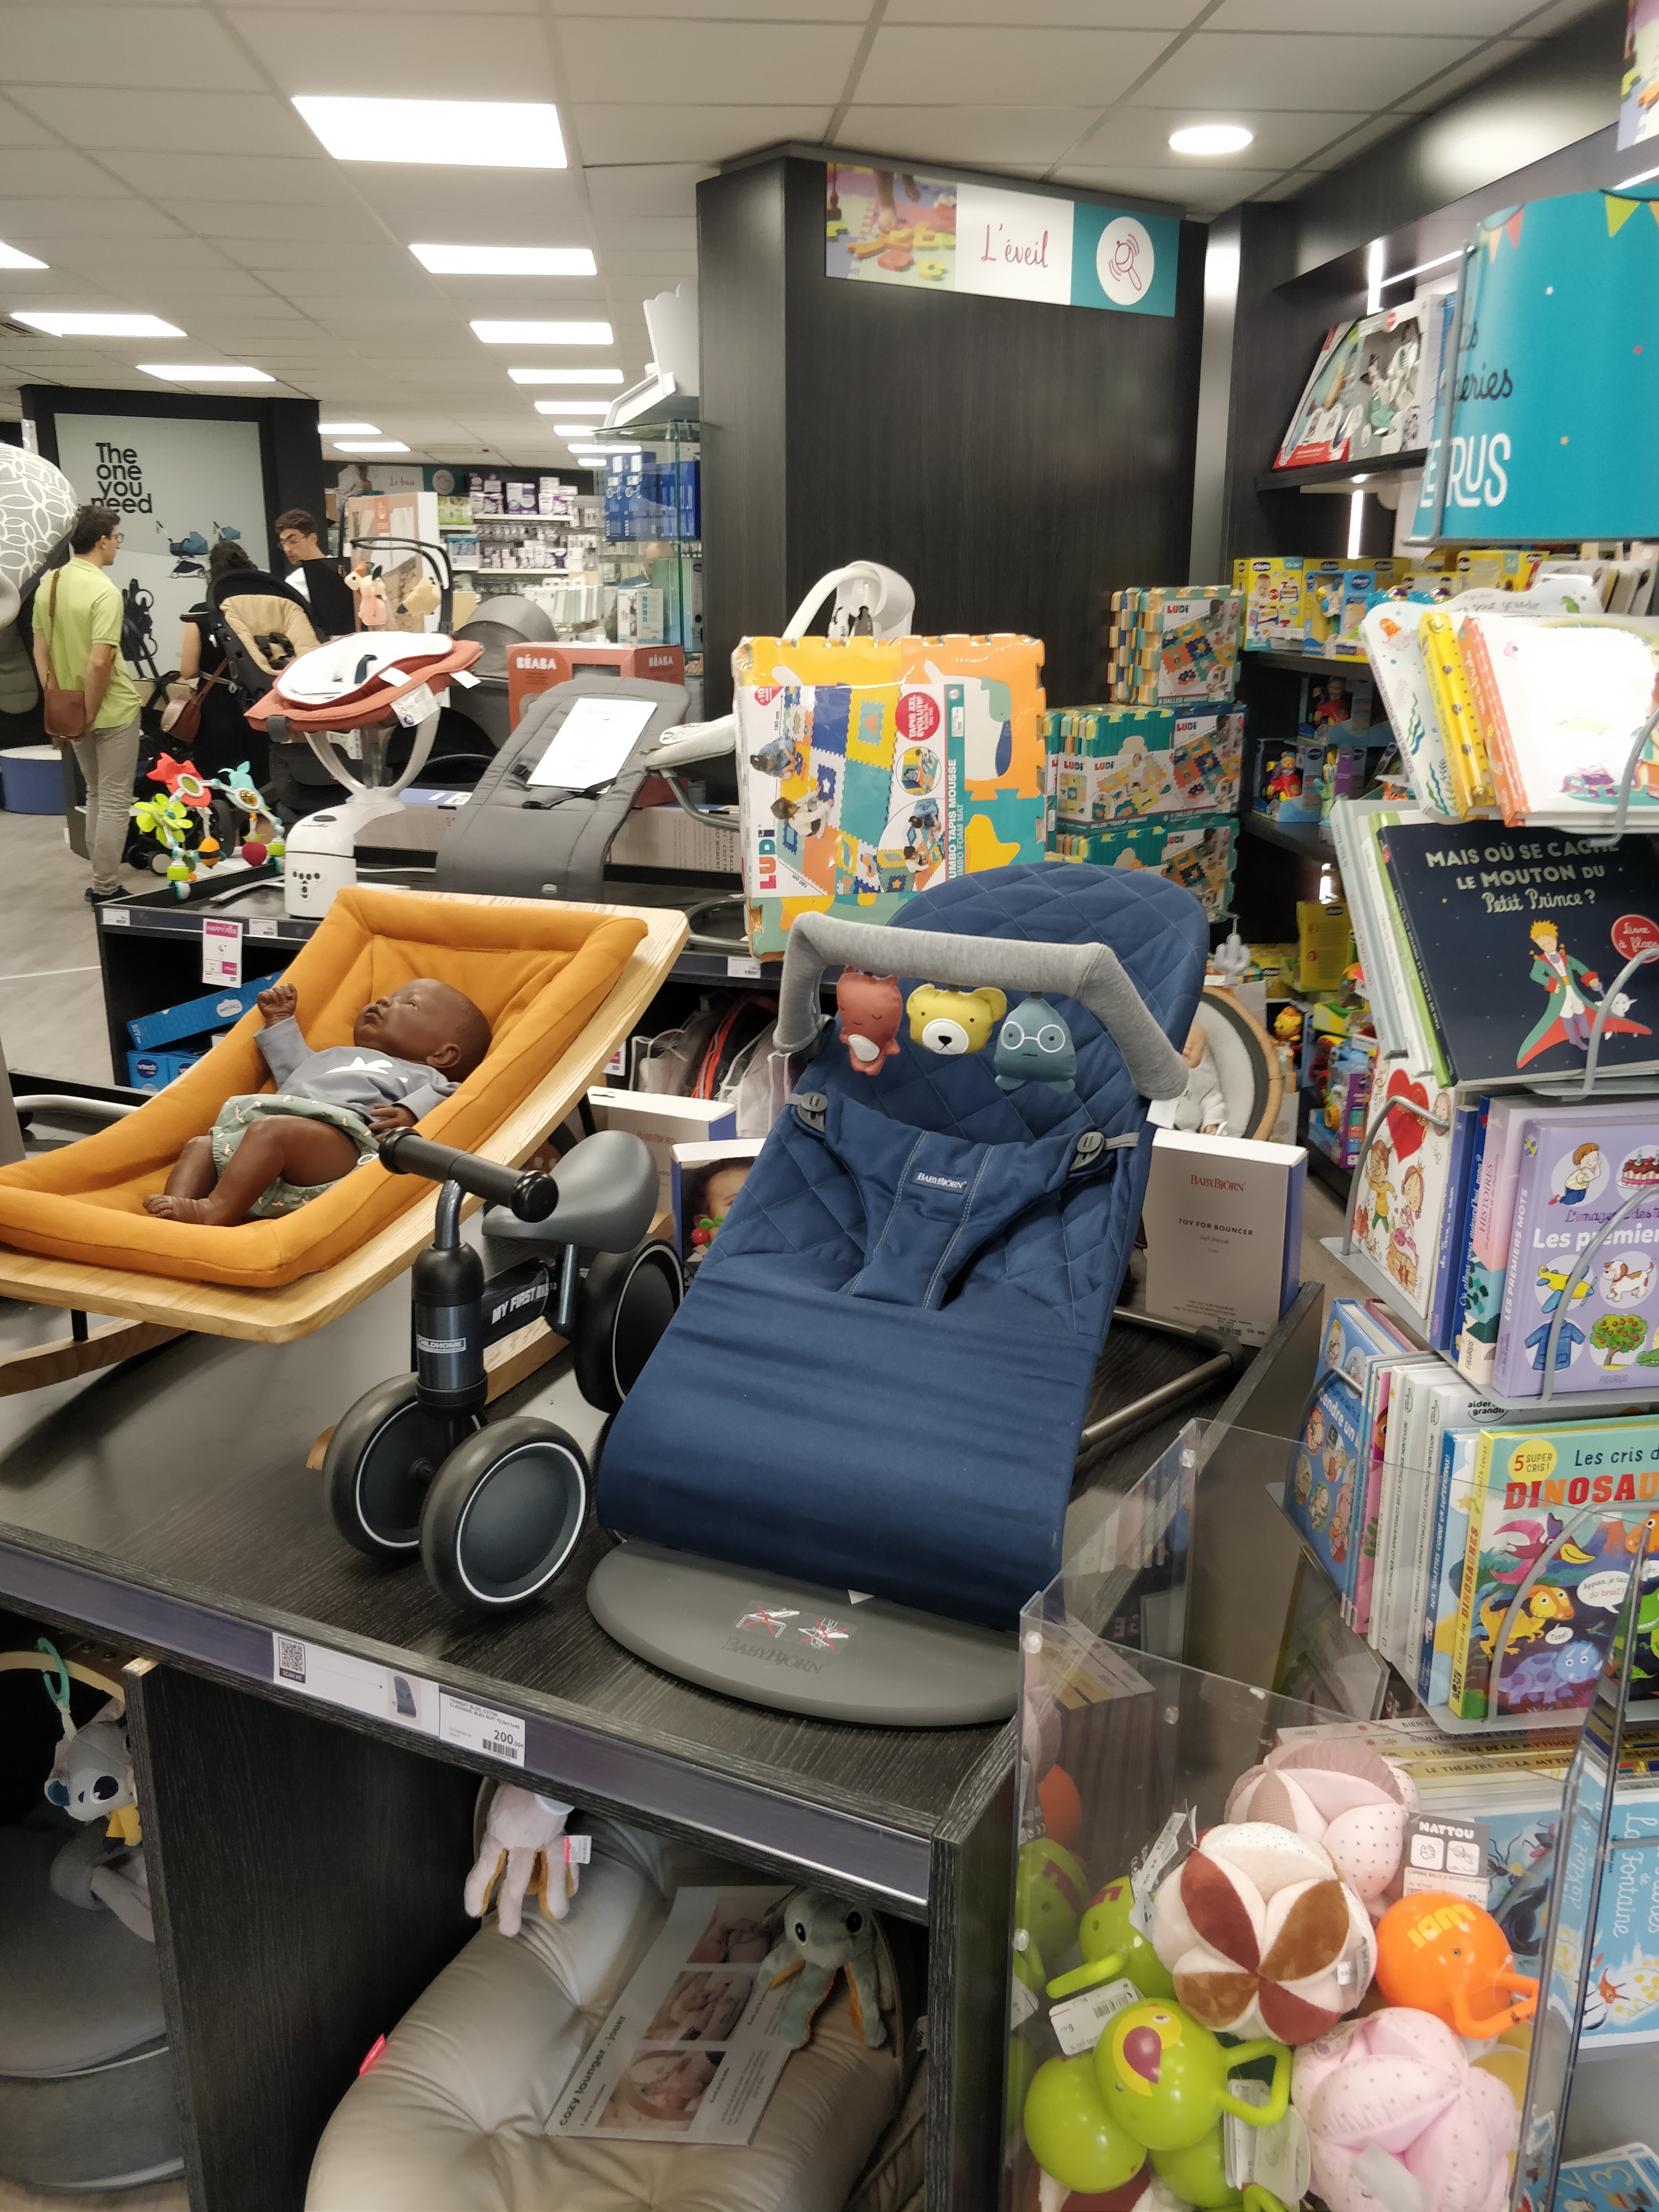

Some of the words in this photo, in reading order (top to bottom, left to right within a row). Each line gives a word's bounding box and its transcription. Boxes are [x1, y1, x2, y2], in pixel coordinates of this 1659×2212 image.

[980, 223, 1049, 268] L'éveil
[95, 443, 138, 464] The
[97, 464, 142, 481] one
[97, 481, 142, 500] you
[91, 493, 153, 514] need
[516, 654, 557, 670] BÉABA
[649, 654, 673, 667] BÉABA
[948, 758, 957, 807] MOUSSE
[948, 809, 956, 842] TAPIS
[948, 844, 957, 879] UMBO
[1425, 849, 1480, 867] MAIS
[1484, 842, 1515, 862] OÙ
[1519, 844, 1543, 860] SE
[1456, 876, 1477, 890] LE
[1480, 865, 1576, 888] MOUTON
[1582, 865, 1605, 878] DU
[1481, 892, 1524, 913] Petit
[1525, 888, 1583, 910] Prince
[1584, 888, 1596, 904] ?
[1190, 1174, 1245, 1192] BABYBJÖRN
[1479, 1164, 1493, 1233] HISTOIRES
[1635, 1205, 1651, 1219] des
[1214, 1225, 1253, 1236] BOUNCER
[1533, 1228, 1571, 1249] Les
[1503, 1298, 1513, 1321] LES
[1508, 1230, 1522, 1296] PREMIERS
[1516, 1189, 1528, 1227] MOTS
[1465, 1339, 1474, 1370] FLEURUS
[1344, 1421, 1355, 1442] un
[1399, 1420, 1409, 1455] MONTESSORI
[1513, 1454, 1525, 1472] 5
[1526, 1453, 1553, 1463] SUPER
[1574, 1450, 1603, 1467] Les
[1610, 1446, 1643, 1464] cris
[1461, 1527, 1478, 1619] DINOSAURES
[1419, 1821, 1475, 1839] NATTOU
[558, 2092, 582, 2127] cozy
[574, 2046, 607, 2096] lounger
[609, 2015, 626, 2044] jouer
